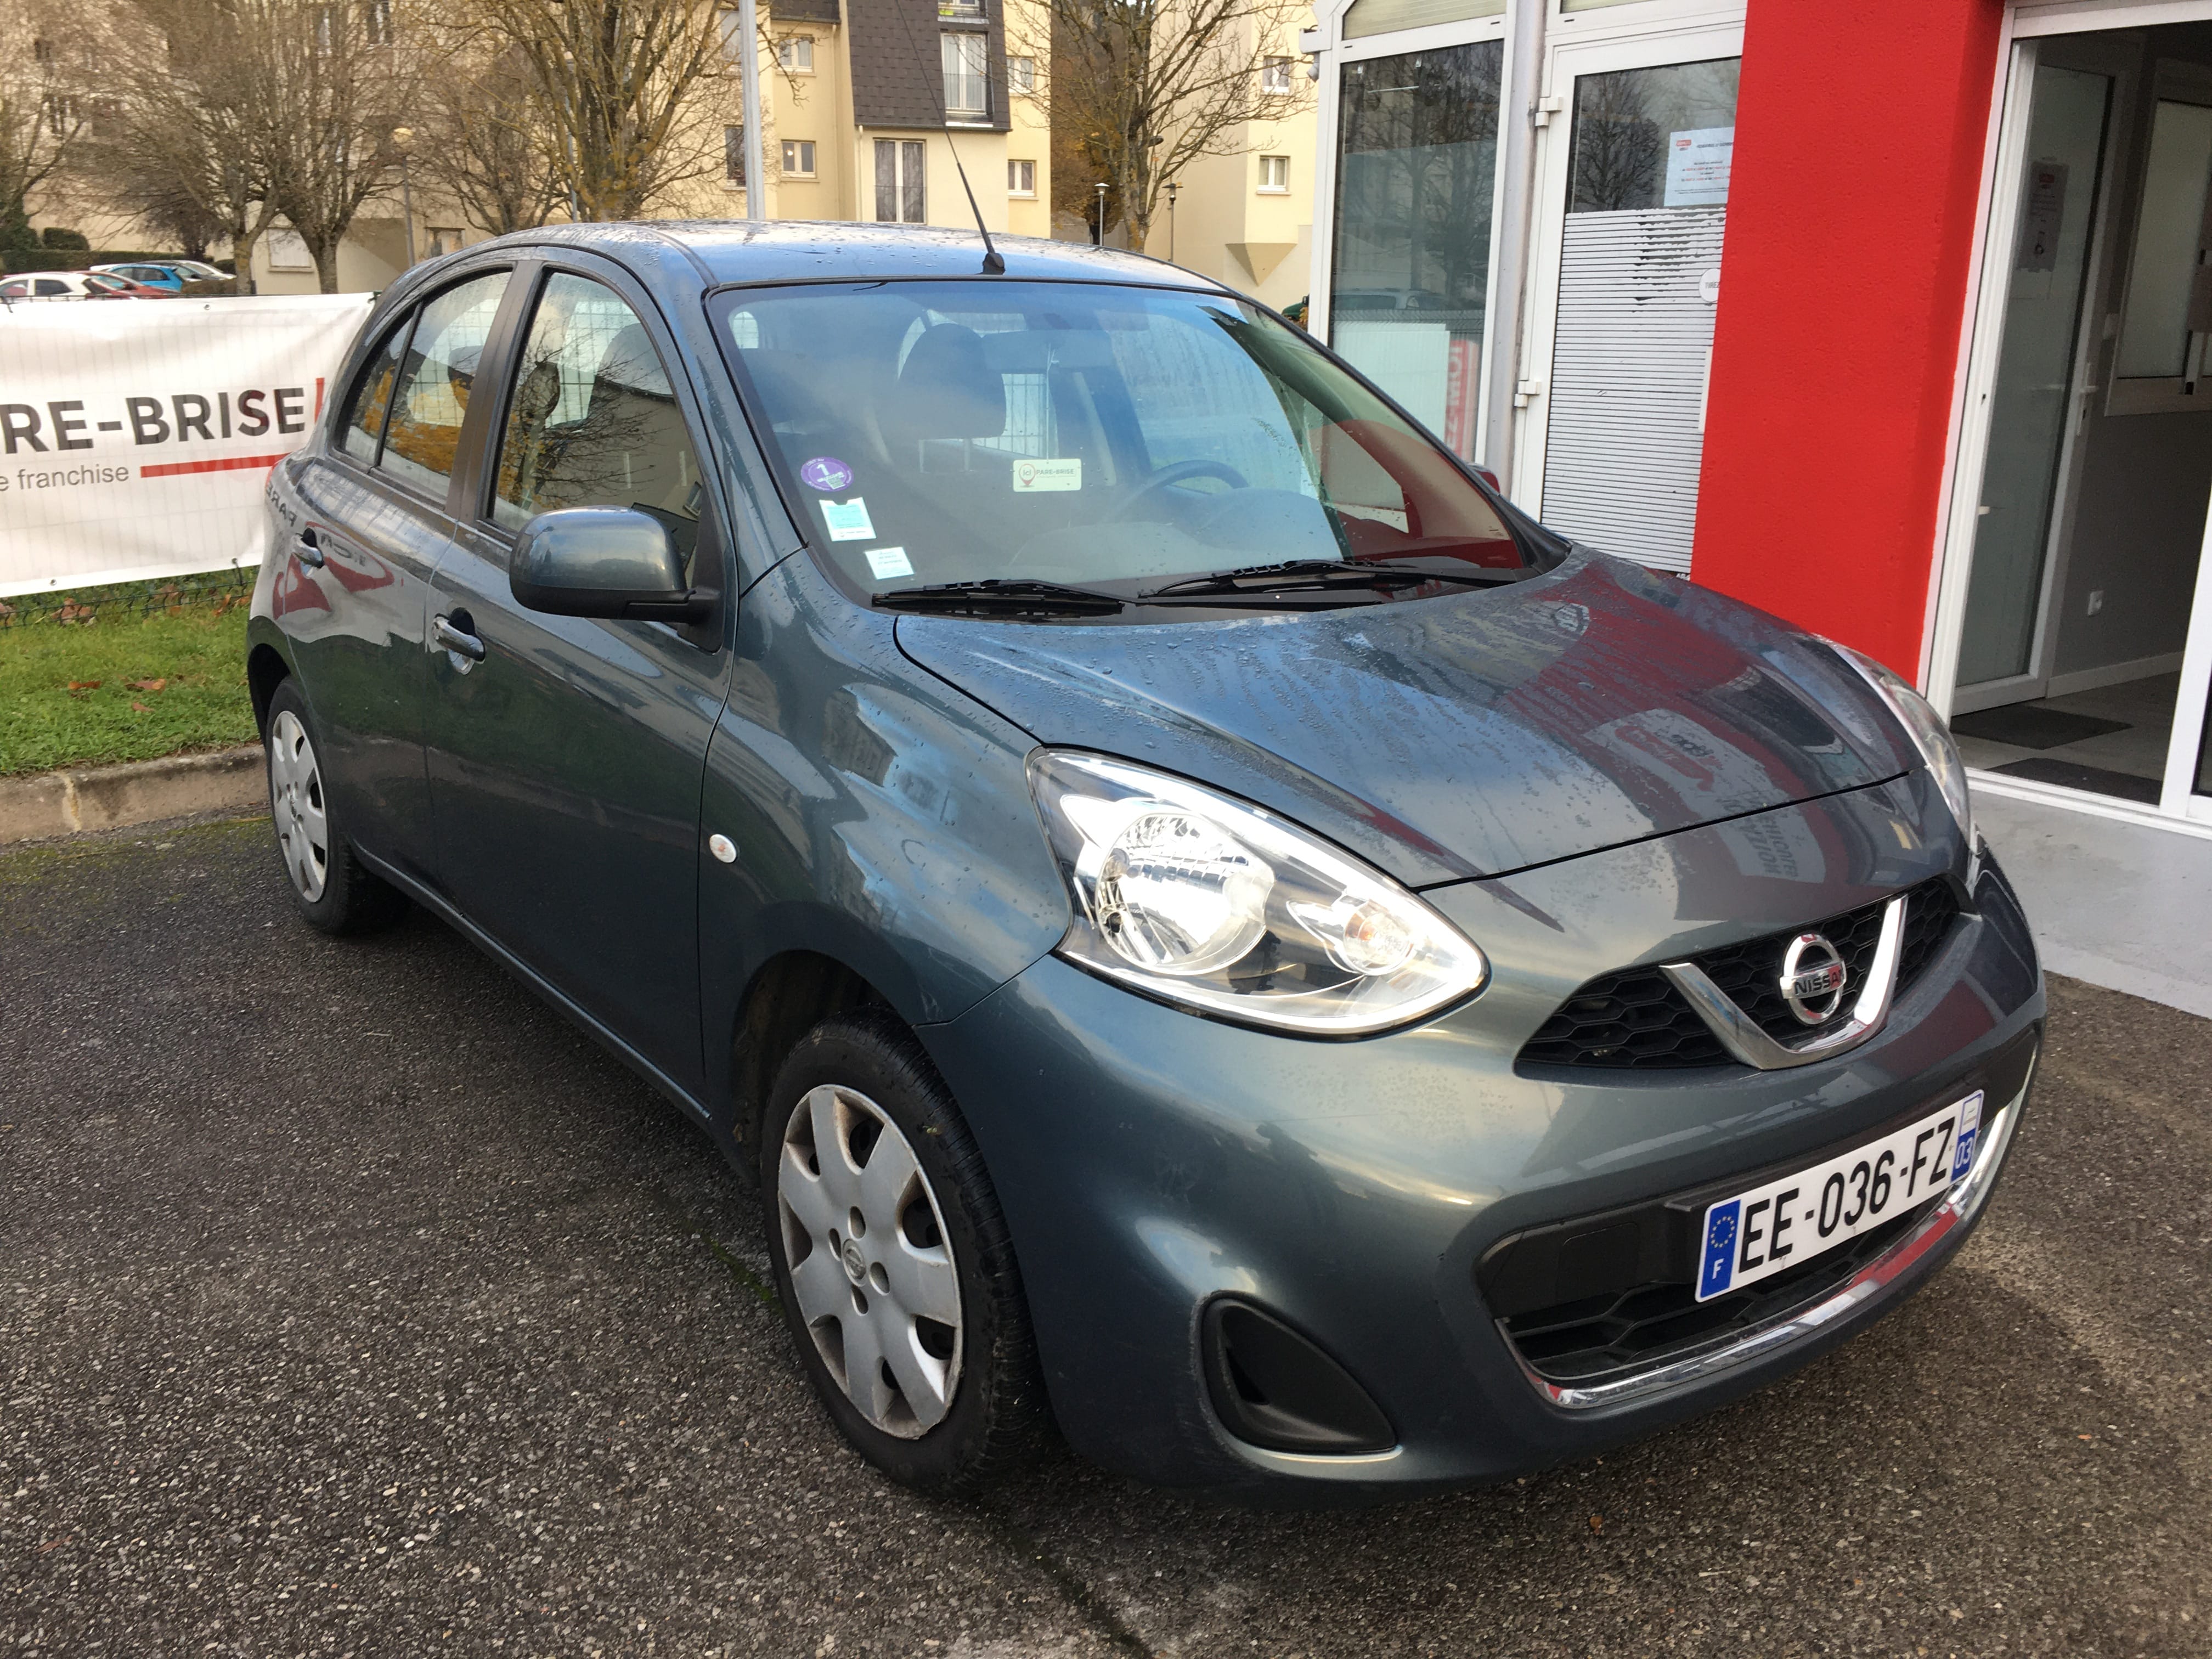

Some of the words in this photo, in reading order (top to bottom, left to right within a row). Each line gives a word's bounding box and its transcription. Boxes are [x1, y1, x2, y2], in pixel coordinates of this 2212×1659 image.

[18, 464, 129, 490] franchise
[1712, 1258, 1725, 1280] F
[1739, 1116, 1955, 1273] EE-036-FZ
[1955, 1137, 1974, 1169] 03
